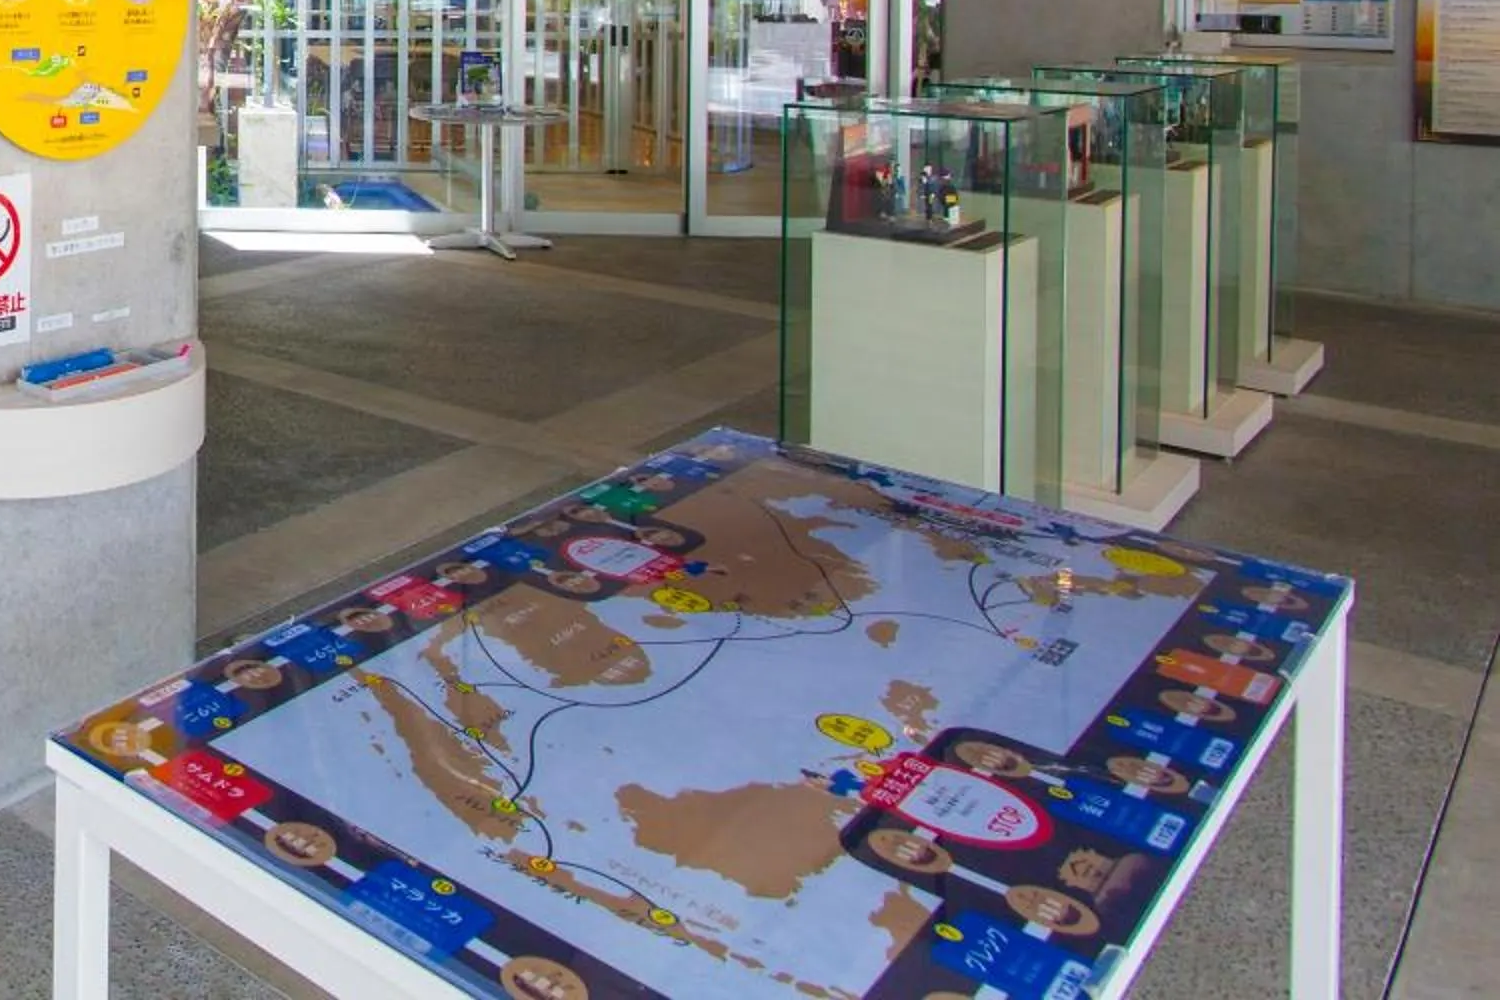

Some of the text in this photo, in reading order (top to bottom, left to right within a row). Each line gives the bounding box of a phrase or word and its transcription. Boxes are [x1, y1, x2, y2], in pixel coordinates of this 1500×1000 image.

[987, 804, 1027, 837] STOP
[389, 877, 464, 928] マラッカ
[963, 926, 1009, 972] グレシク
